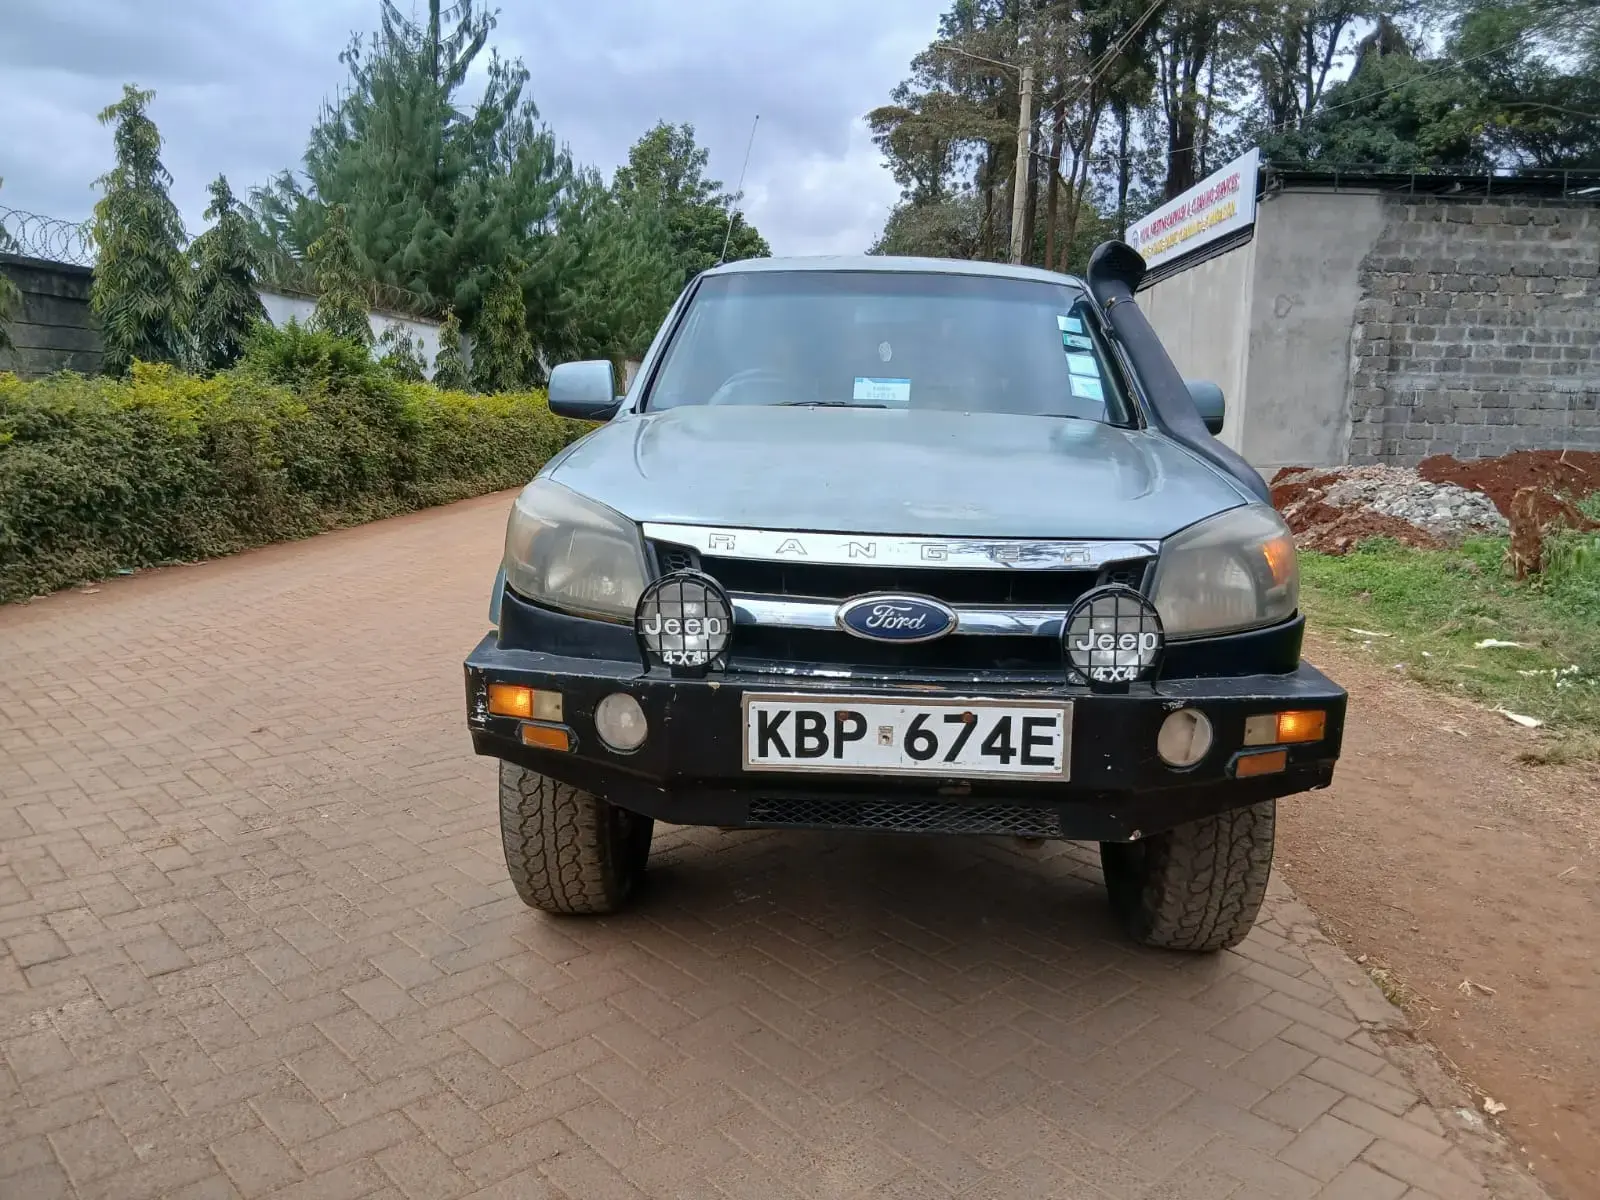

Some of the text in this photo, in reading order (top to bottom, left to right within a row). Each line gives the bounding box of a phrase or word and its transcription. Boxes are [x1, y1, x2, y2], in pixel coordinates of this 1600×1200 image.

[708, 533, 1091, 563] RANGER
[645, 613, 721, 639] Jeep
[866, 604, 927, 629] Ford
[1076, 628, 1156, 655] Jeep
[757, 710, 1058, 766] KBP 674E
